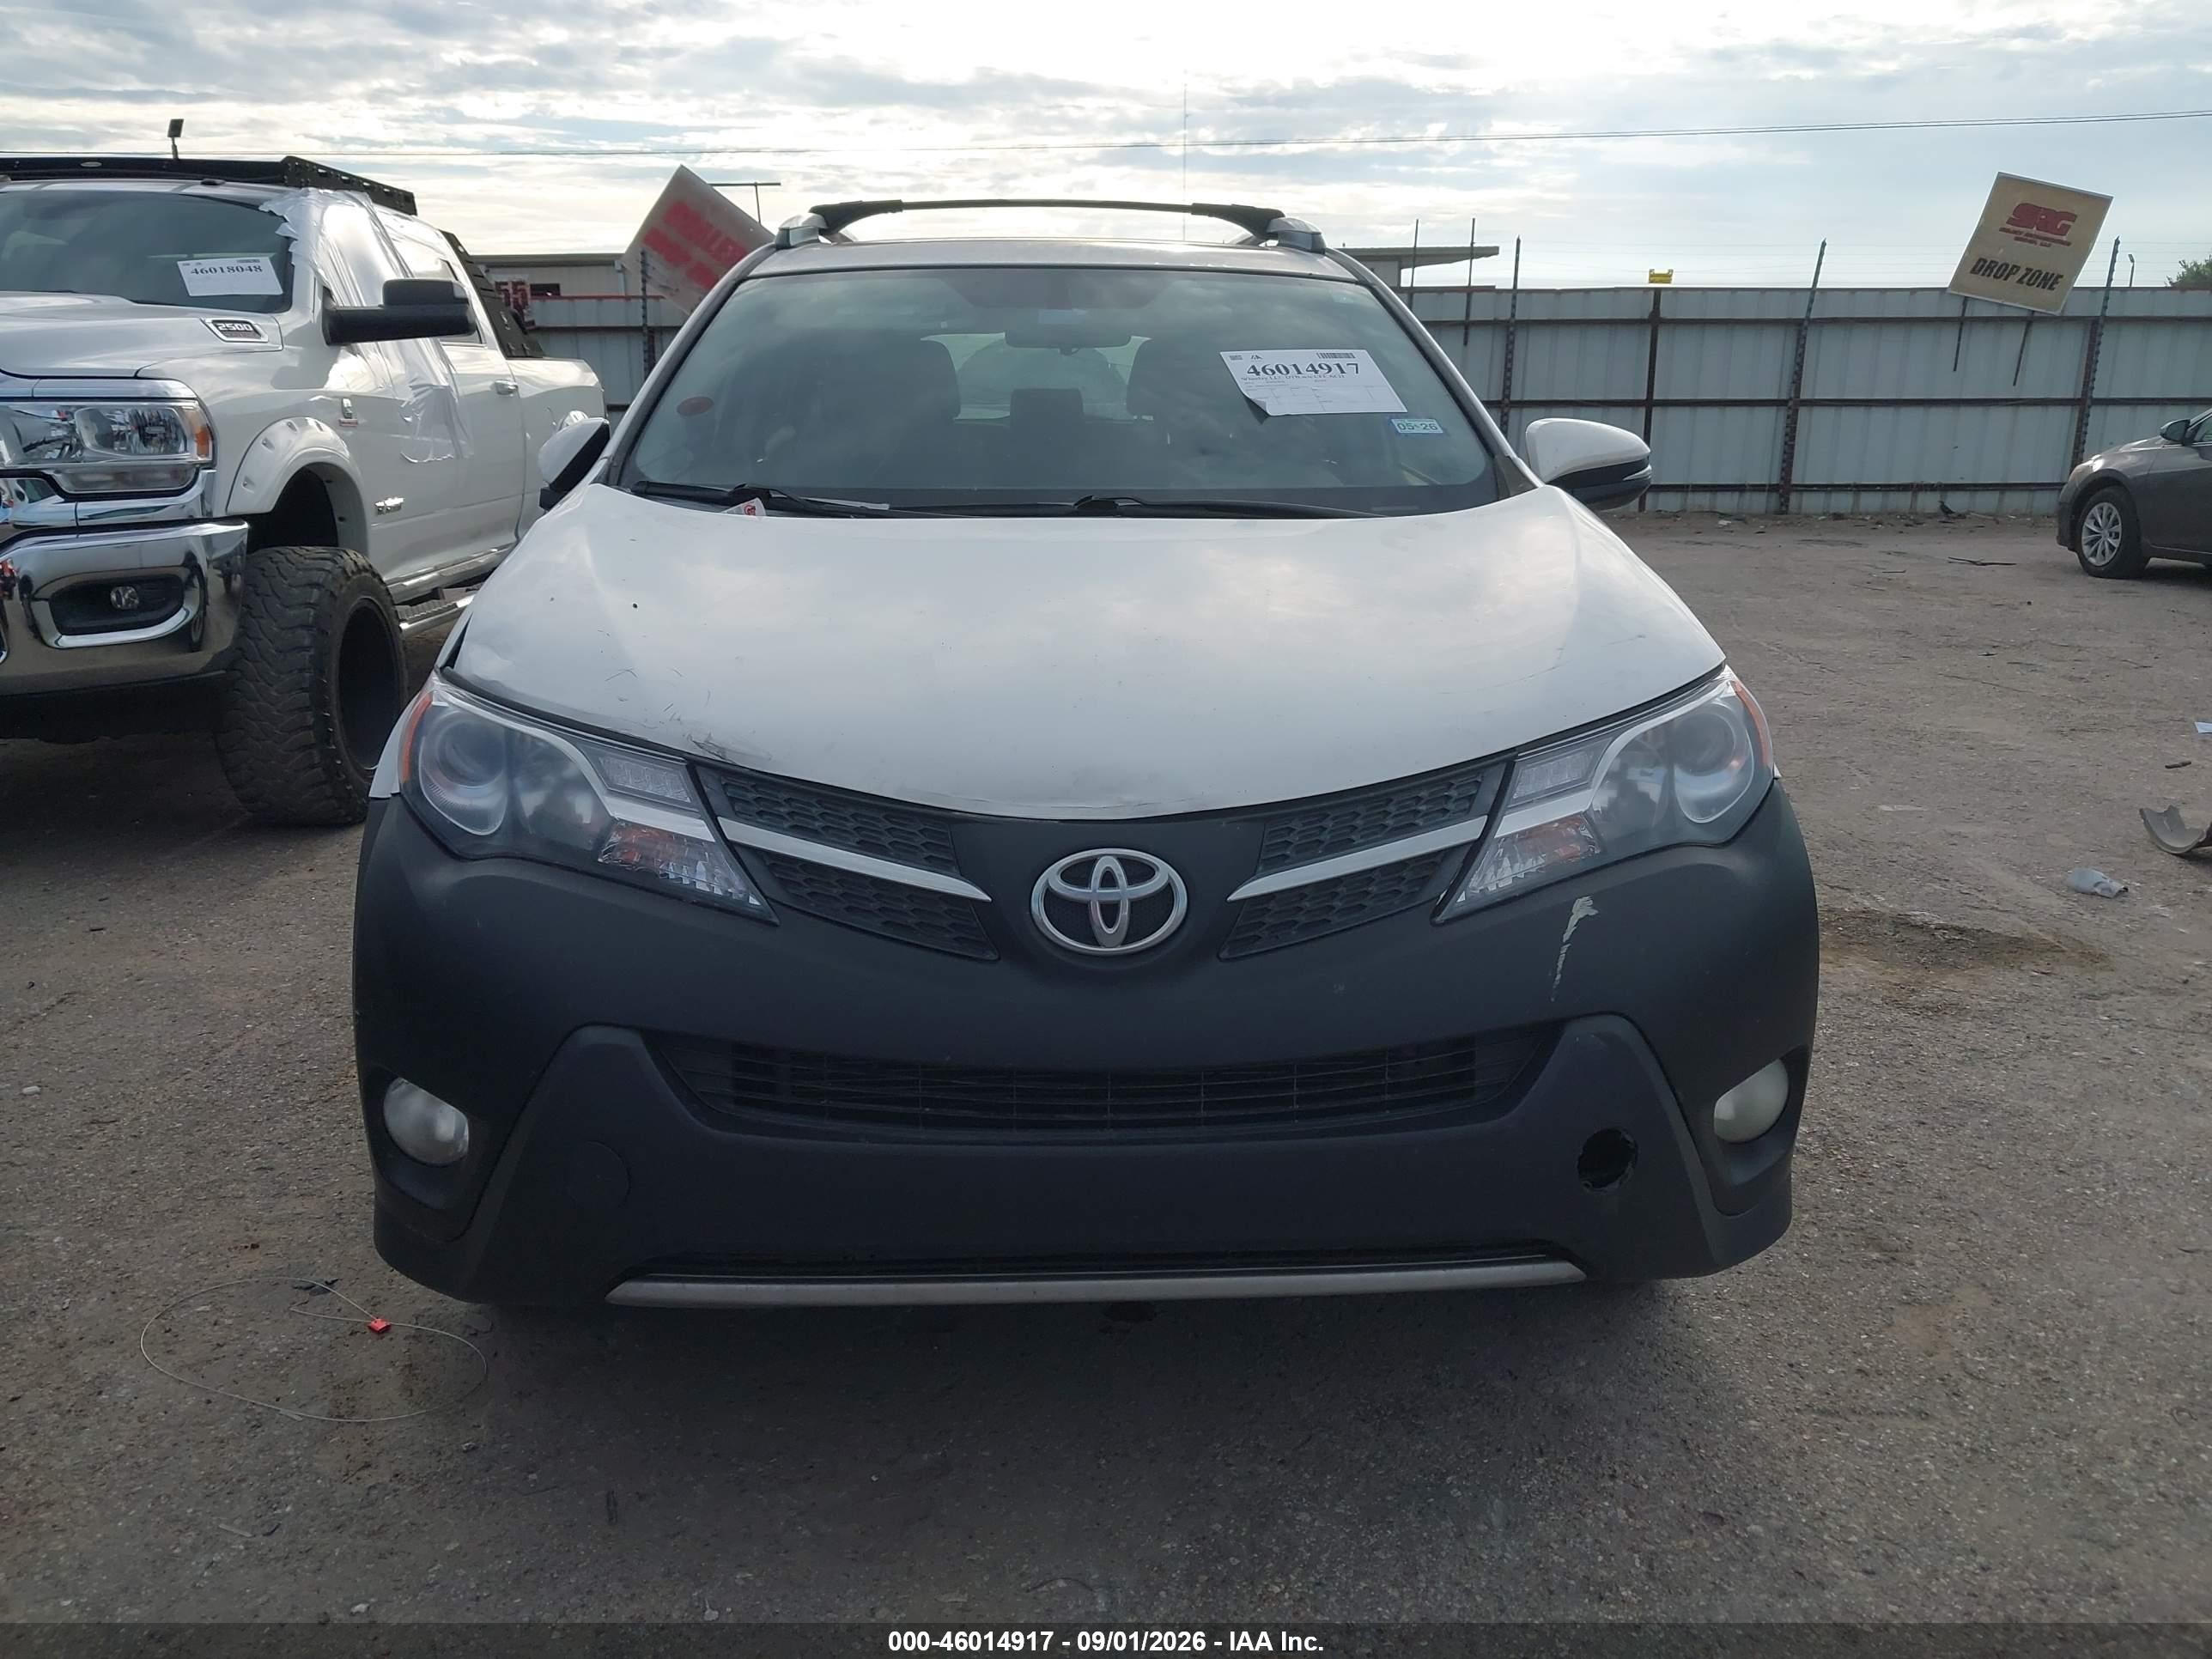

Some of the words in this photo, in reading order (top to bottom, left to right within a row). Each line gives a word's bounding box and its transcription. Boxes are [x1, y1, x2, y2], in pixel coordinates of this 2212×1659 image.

[191, 264, 263, 275] 46018048
[1969, 257, 2021, 282] DROP
[2017, 266, 2064, 291] ZONE
[216, 323, 253, 331] 2500
[1246, 362, 1360, 376] 46014917
